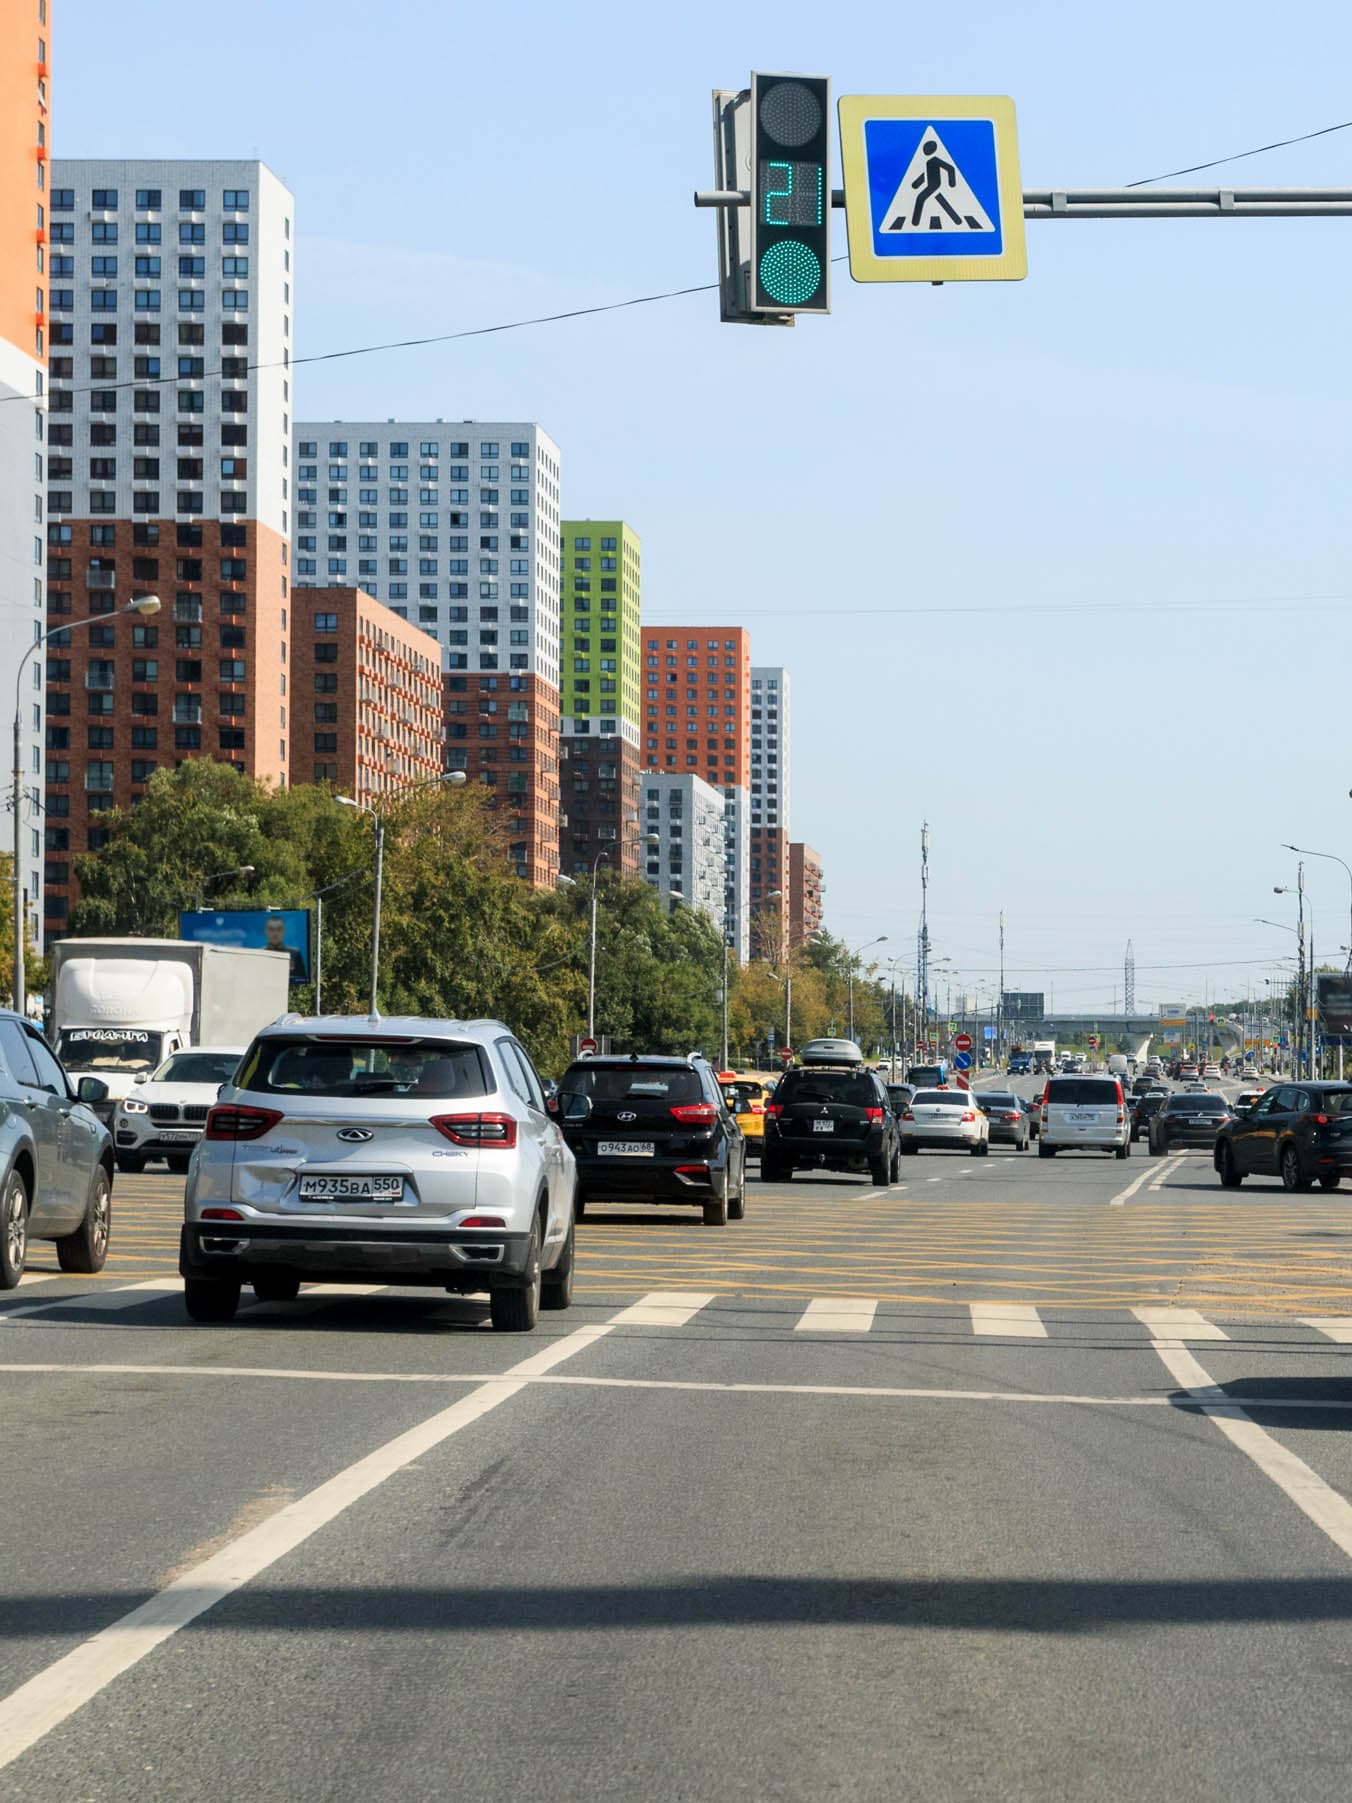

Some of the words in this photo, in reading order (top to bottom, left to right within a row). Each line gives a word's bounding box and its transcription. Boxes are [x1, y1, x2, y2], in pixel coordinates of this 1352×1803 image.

[765, 163, 823, 225] 21
[600, 1143, 640, 1152] О943АО
[305, 1178, 370, 1195] М935ВА
[374, 1178, 400, 1190] 550
